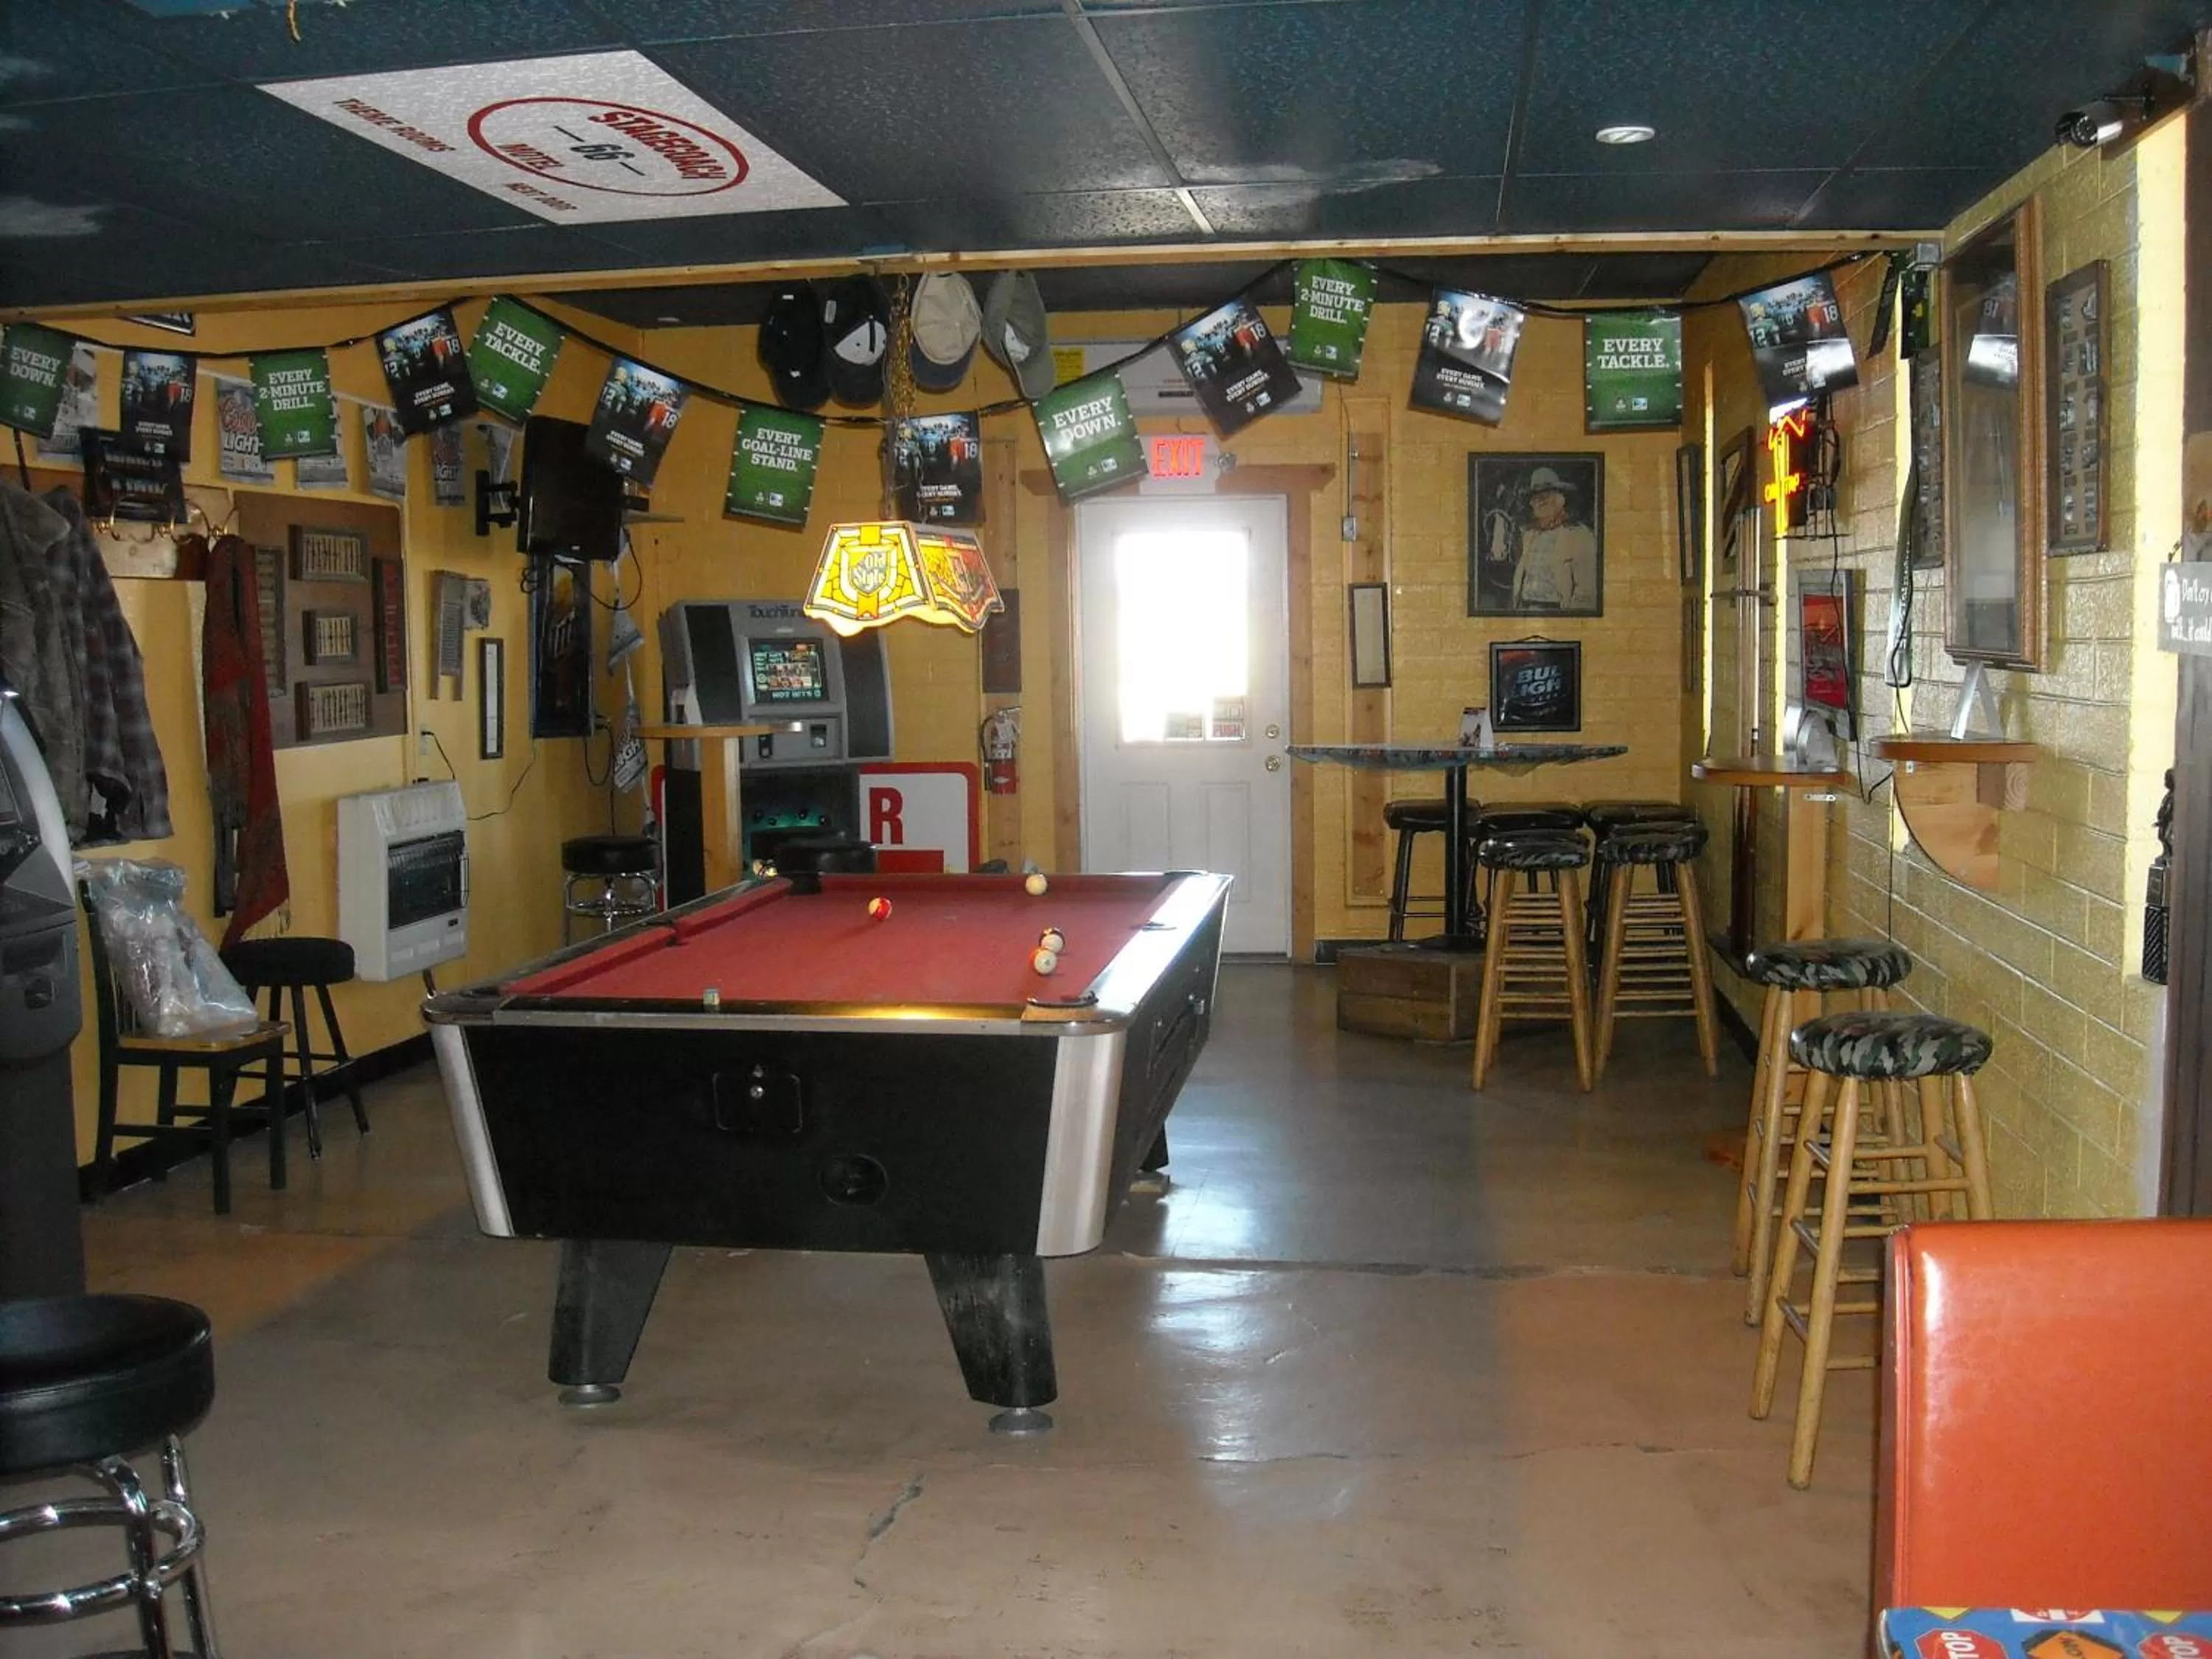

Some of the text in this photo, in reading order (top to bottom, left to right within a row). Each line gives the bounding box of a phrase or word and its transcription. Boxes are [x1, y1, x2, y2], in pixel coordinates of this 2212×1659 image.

[333, 97, 456, 153] THEME ROOMS
[568, 144, 636, 161] 66
[587, 111, 728, 179] STAGECOACH
[496, 143, 566, 170] MOTEL
[1312, 275, 1356, 296] EVERY
[1300, 288, 1366, 313] 2-MINUTE
[1310, 305, 1348, 324] DRILL.
[1822, 305, 1839, 324] 18
[494, 321, 547, 357] EVERY
[1602, 338, 1665, 353] EVERY
[10, 347, 62, 372] EVERY
[484, 332, 541, 375] TACKLE.
[1596, 354, 1671, 369] TACKLE.
[268, 368, 313, 384] EVERY
[259, 381, 326, 400] 2-MINUTE
[273, 396, 316, 411] DRILL.
[1051, 396, 1113, 429] EVERY
[661, 411, 678, 429] 18
[1060, 412, 1122, 444] DOWN.
[757, 428, 803, 445] EVERY
[741, 437, 814, 462] GOAL-LINE
[964, 442, 978, 460] 18
[1152, 437, 1206, 478] EXIT
[751, 453, 799, 473] STAND.
[864, 551, 886, 568] Old
[852, 566, 886, 591] Style
[869, 787, 904, 846] R
